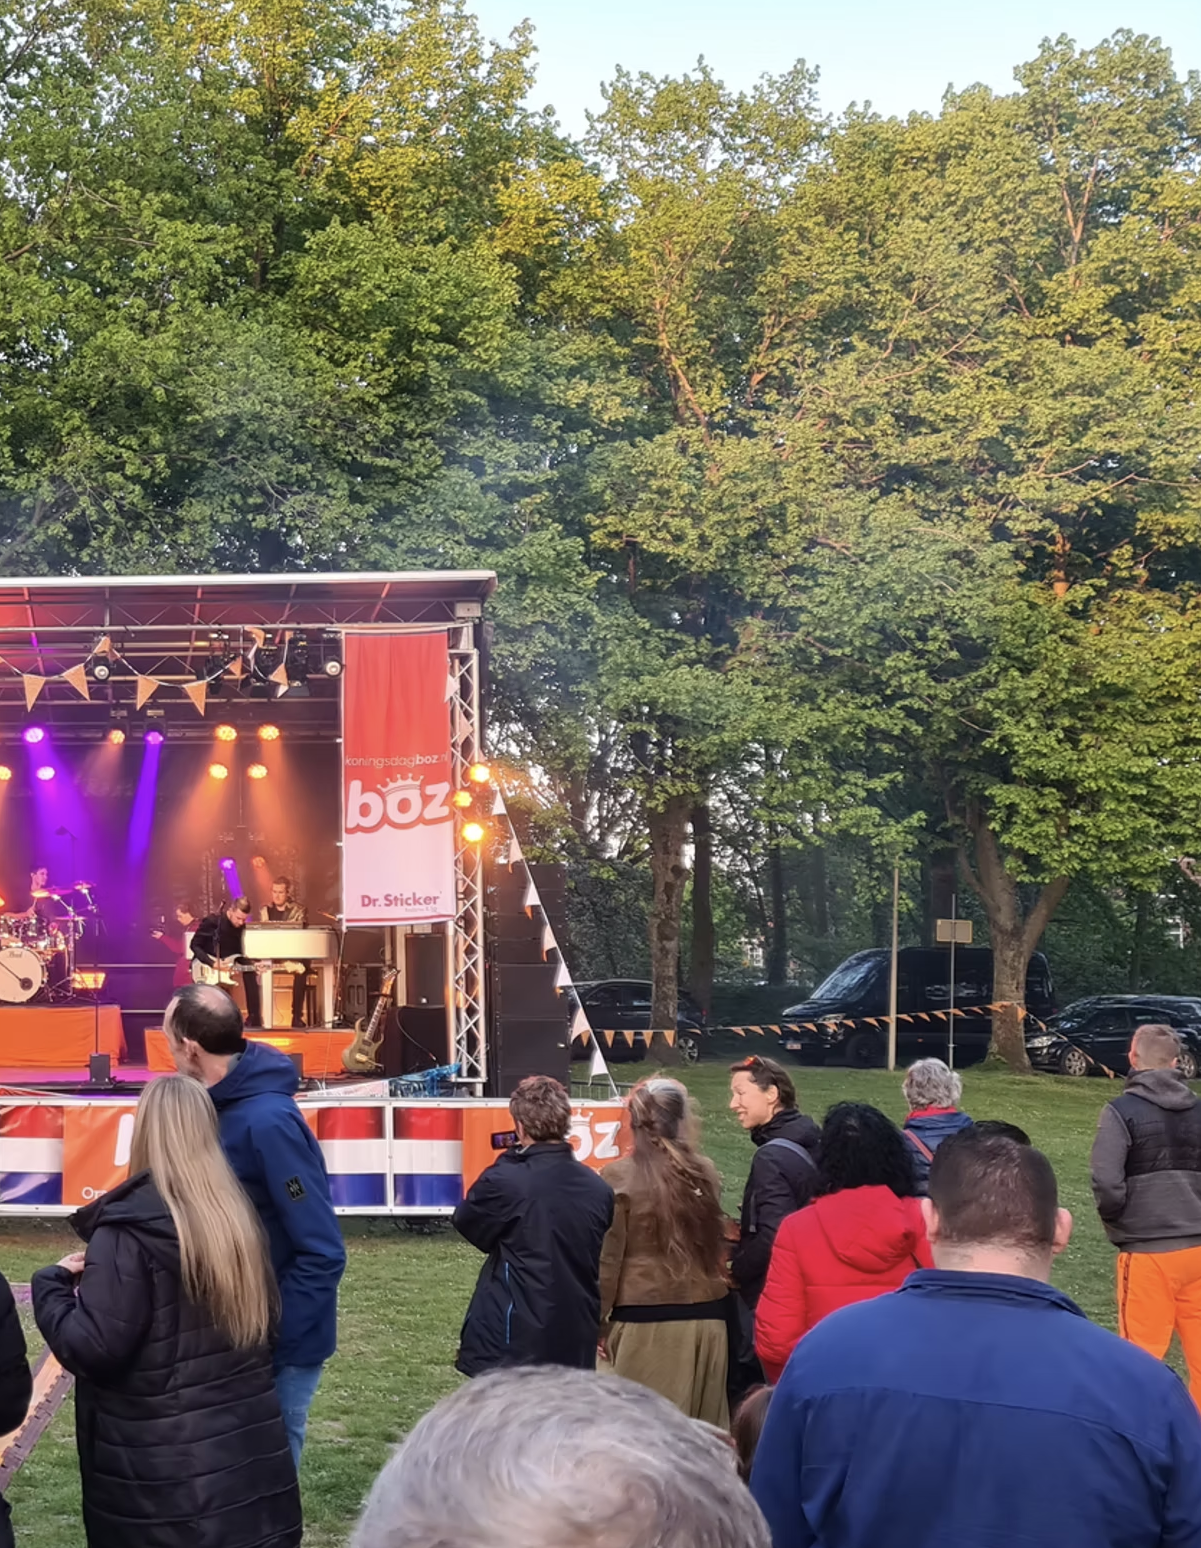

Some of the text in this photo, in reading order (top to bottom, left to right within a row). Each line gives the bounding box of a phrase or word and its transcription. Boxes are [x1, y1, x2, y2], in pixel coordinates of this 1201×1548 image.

[360, 892, 440, 908] Dr. Sticker
[566, 1121, 621, 1162] oz
